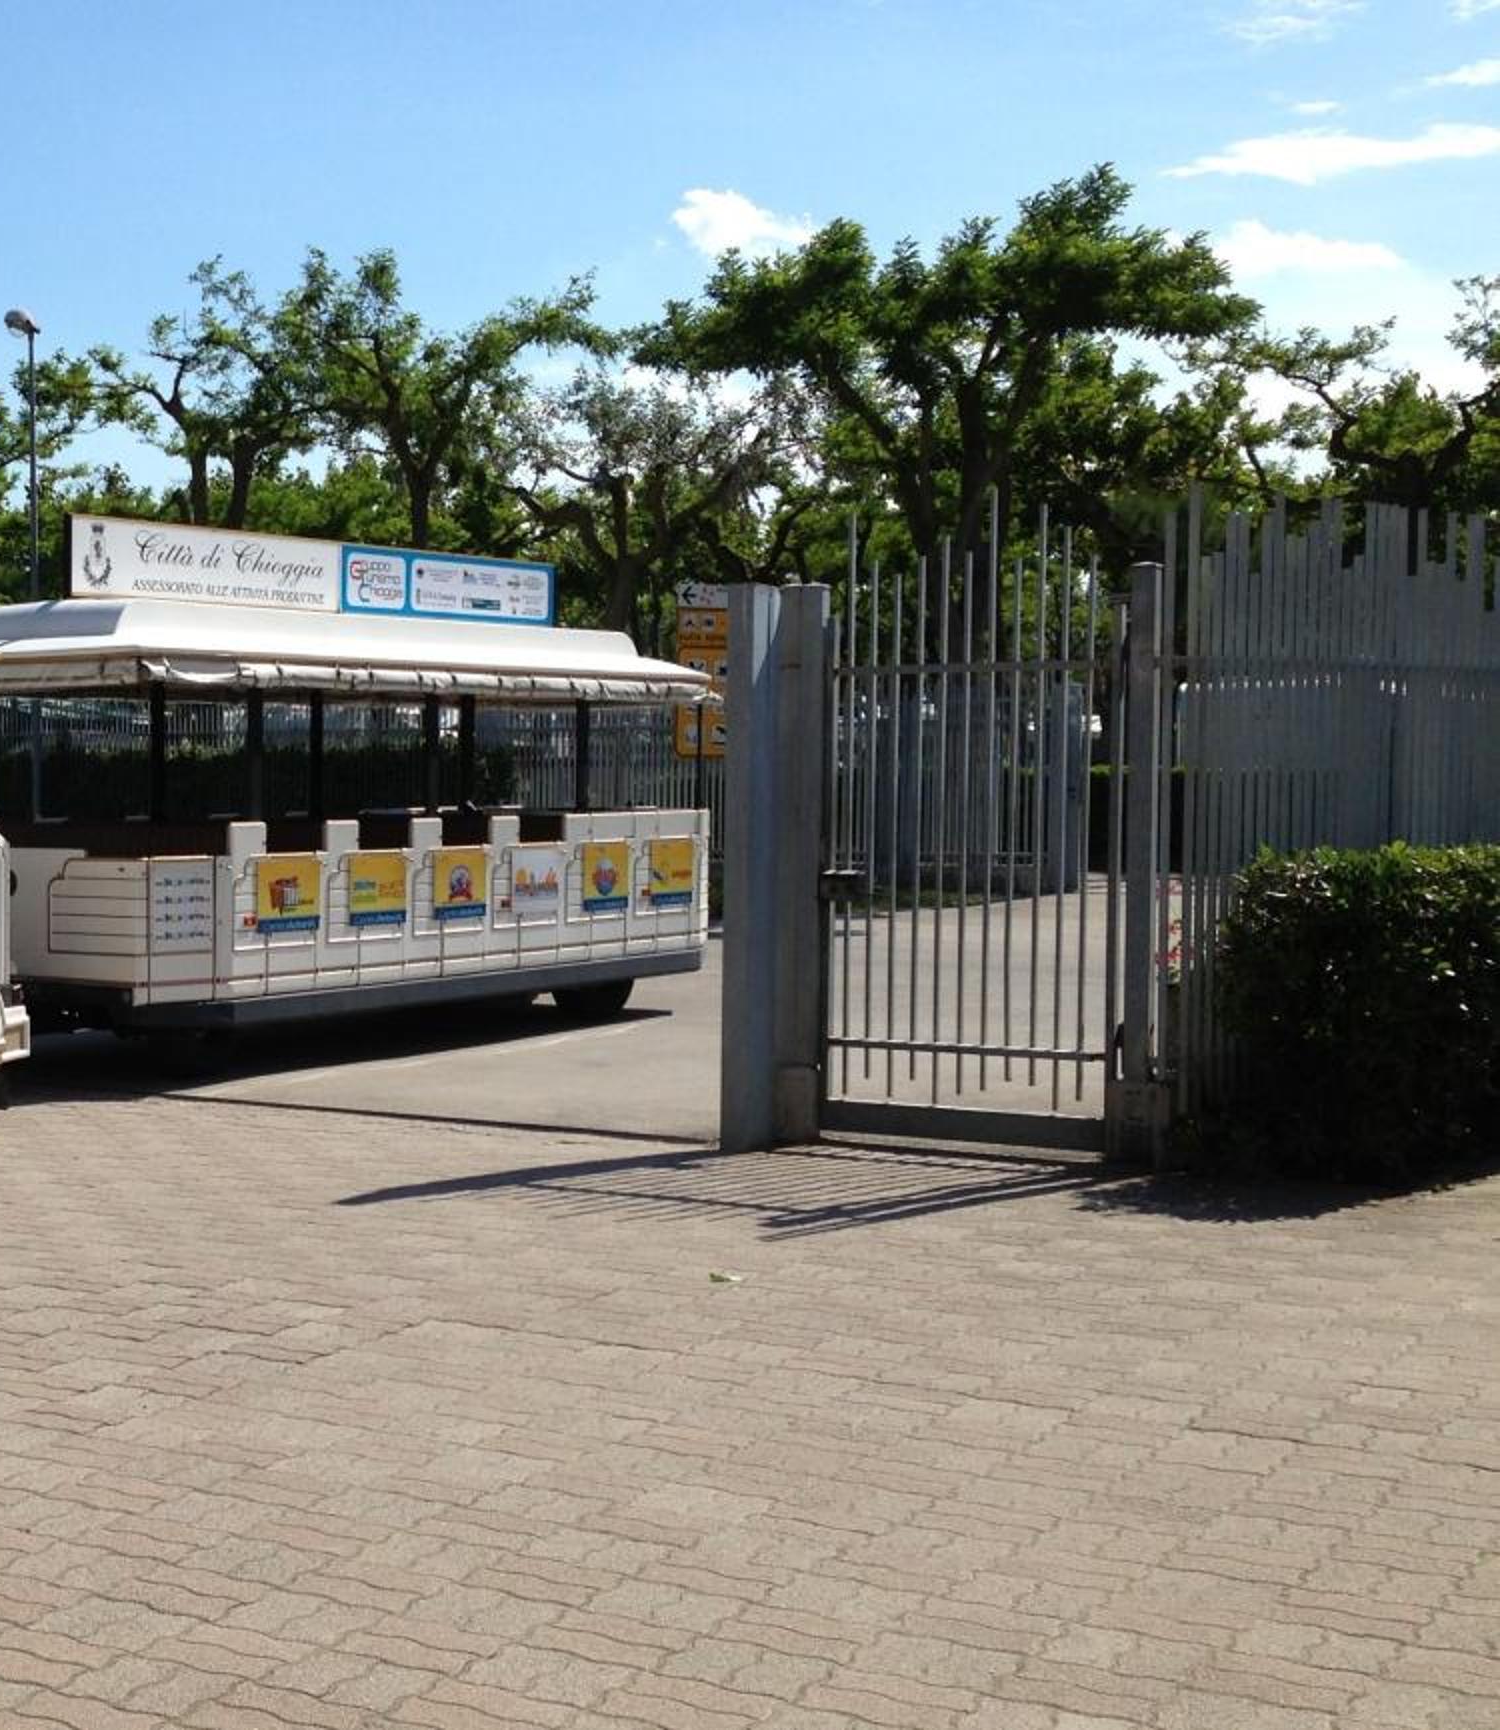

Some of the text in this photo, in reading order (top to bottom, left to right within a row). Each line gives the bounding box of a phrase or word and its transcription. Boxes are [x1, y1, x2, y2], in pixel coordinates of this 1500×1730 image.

[134, 530, 325, 587] Città di Chioggia
